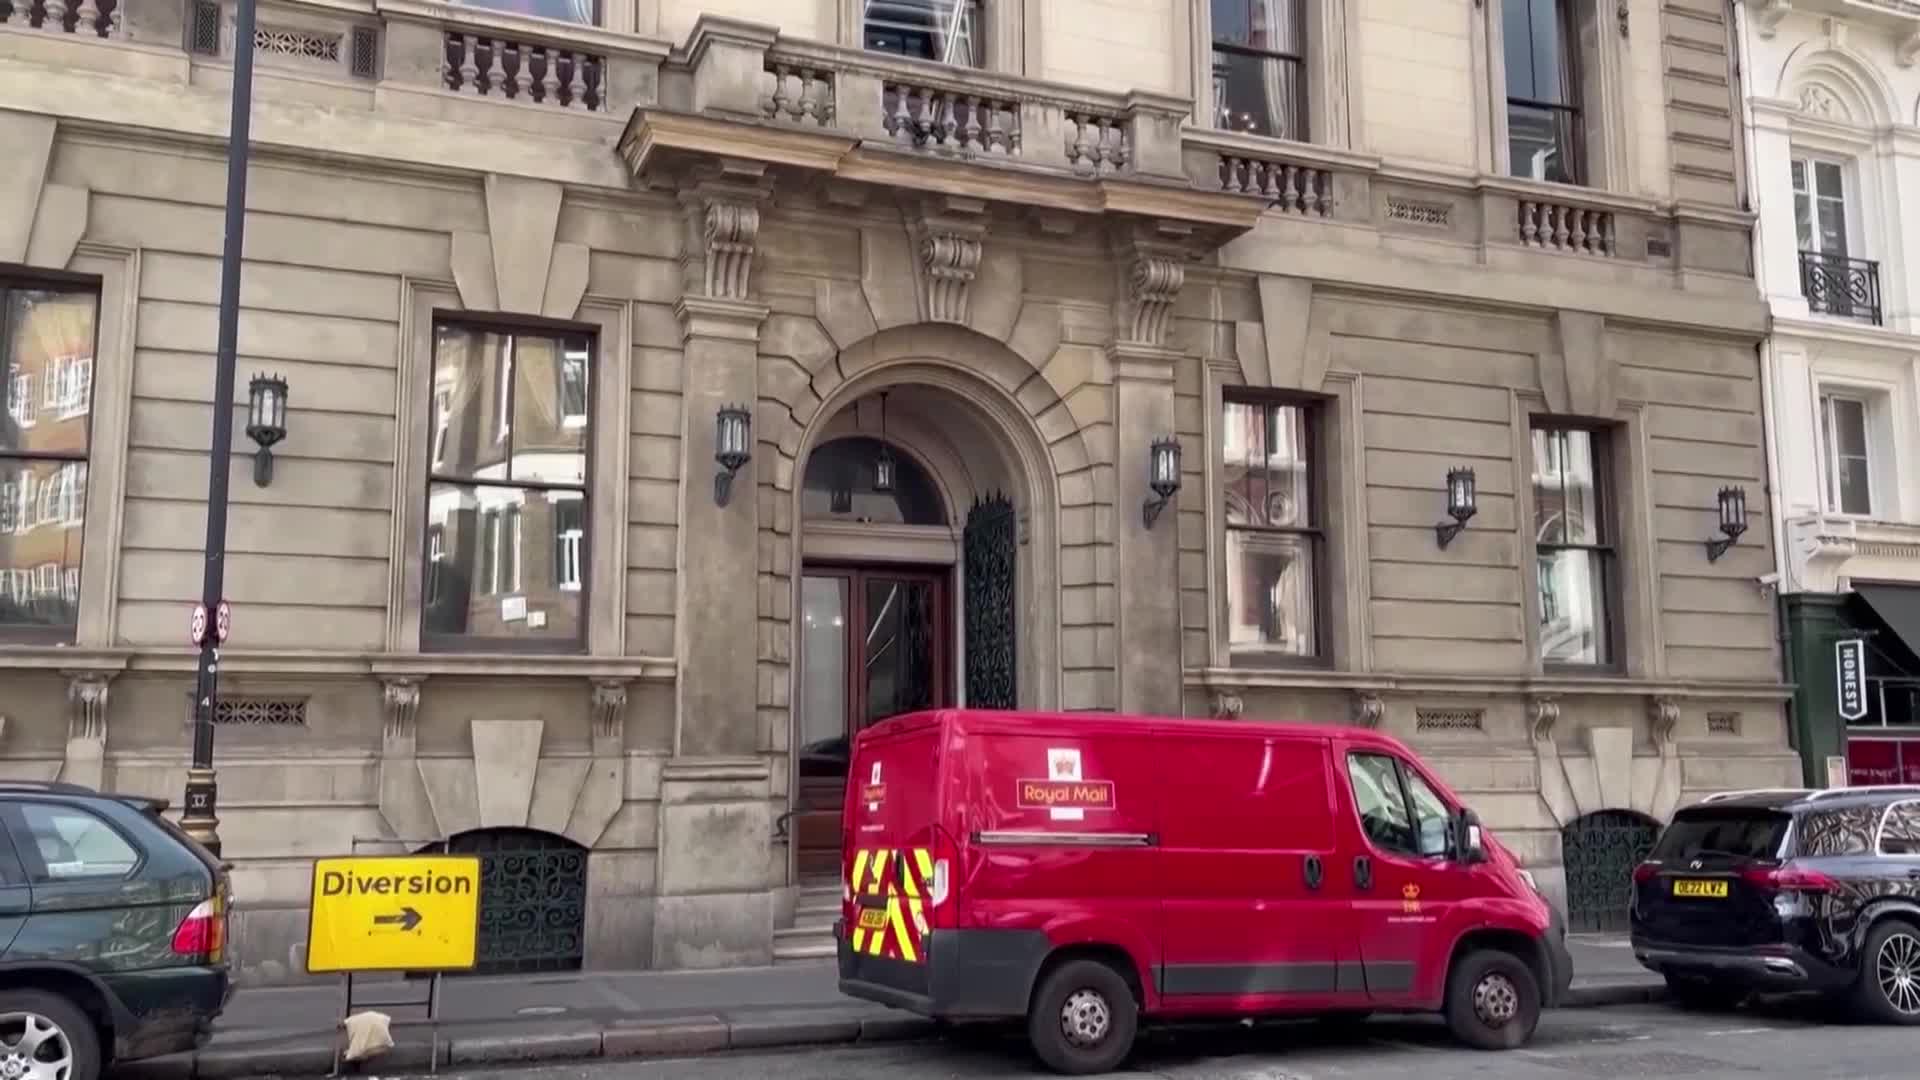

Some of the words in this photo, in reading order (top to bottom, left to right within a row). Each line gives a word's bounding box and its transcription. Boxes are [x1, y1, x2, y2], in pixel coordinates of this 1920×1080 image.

[1843, 648, 1858, 709] HONEST
[1025, 785, 1069, 802] Royal
[1073, 785, 1107, 801] Mail
[323, 869, 470, 896] Diversion
